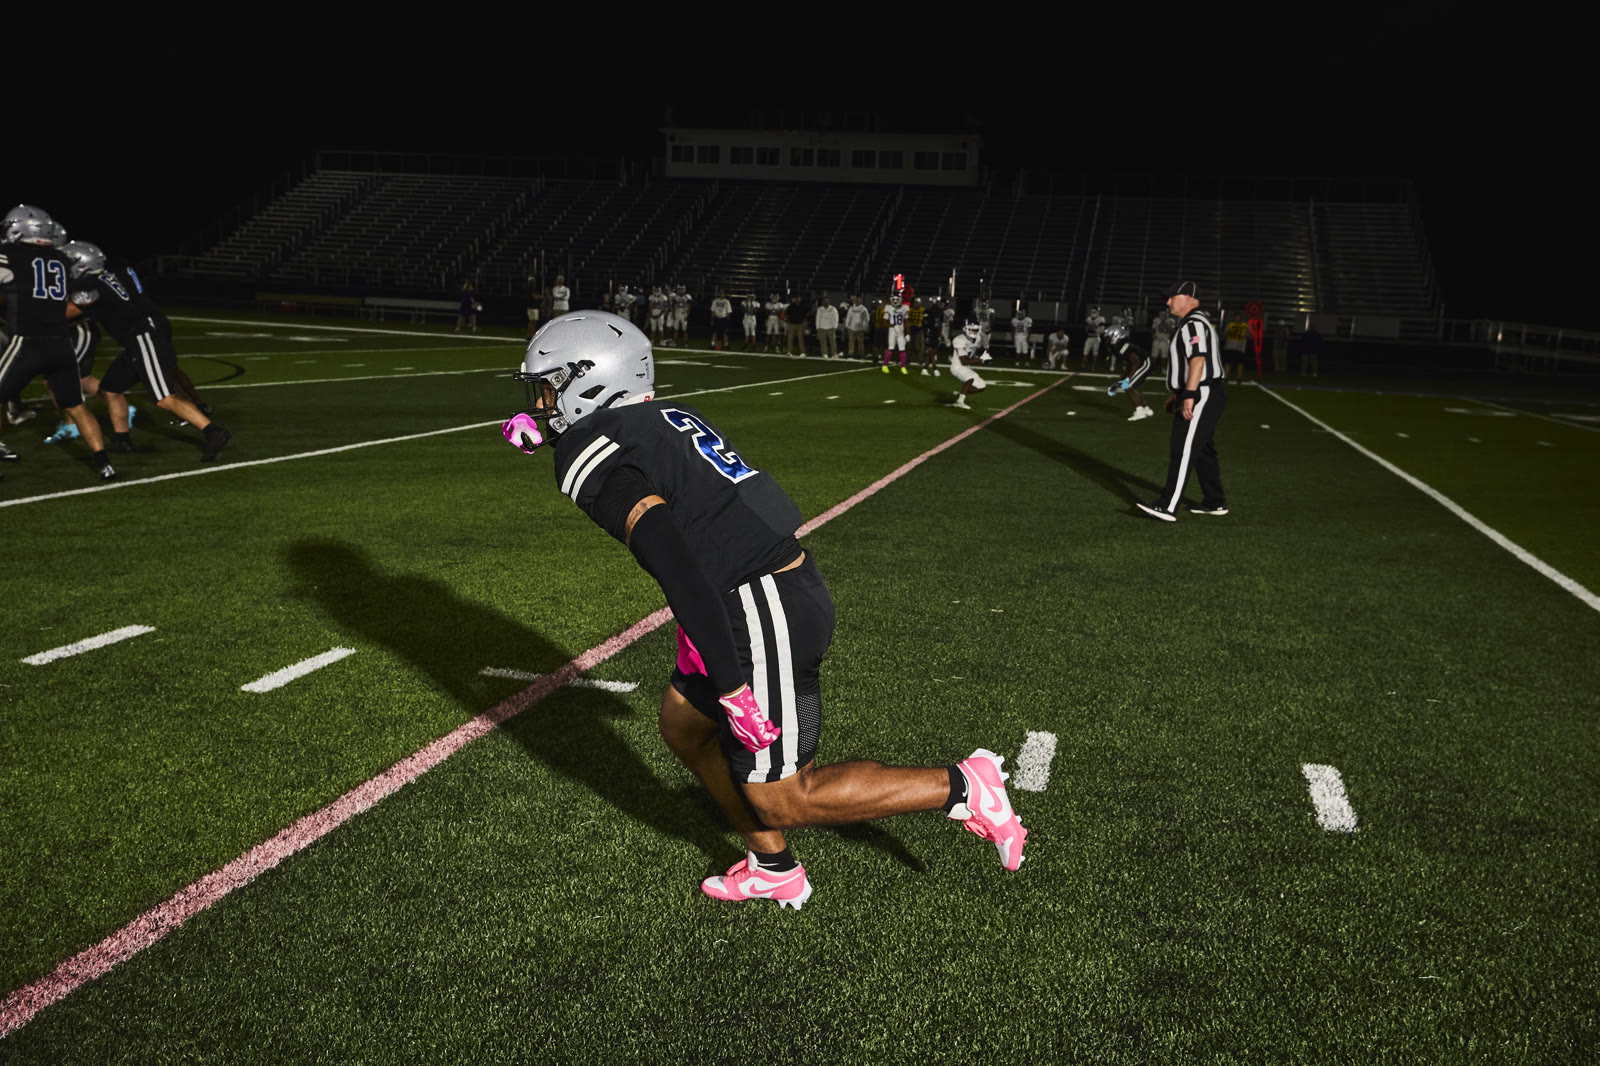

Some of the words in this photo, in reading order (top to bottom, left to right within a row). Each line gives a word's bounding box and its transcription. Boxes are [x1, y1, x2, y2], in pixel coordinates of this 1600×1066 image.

[32, 257, 67, 301] 13
[893, 314, 903, 326] 18
[660, 407, 760, 485] 2
